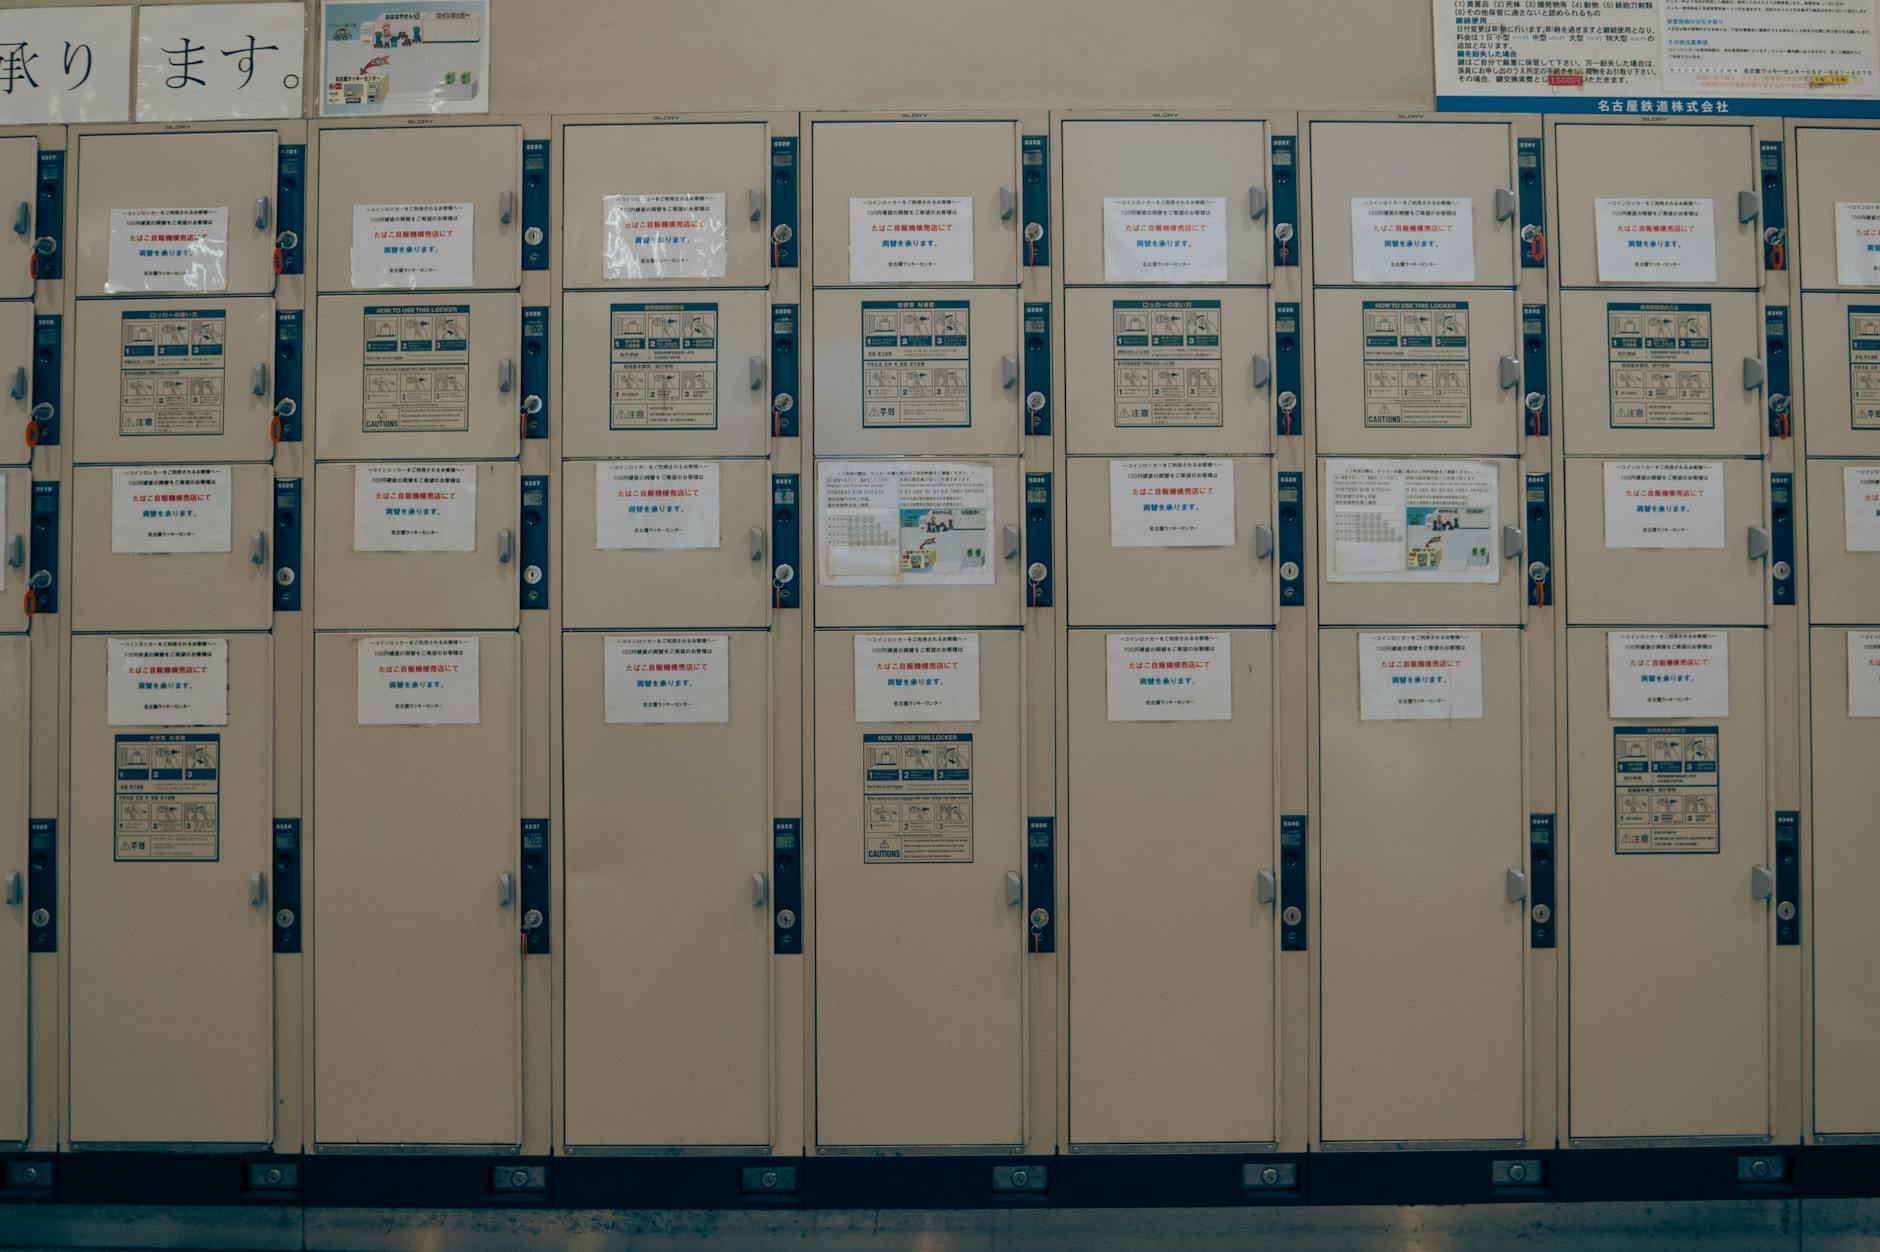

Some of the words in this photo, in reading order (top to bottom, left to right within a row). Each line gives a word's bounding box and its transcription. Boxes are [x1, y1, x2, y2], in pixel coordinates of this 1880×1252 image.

[1597, 100, 1729, 113] 名古屋鉄道株式会社
[1368, 415, 1401, 424] CAUTIONS
[366, 420, 398, 428] CAUTIONS
[868, 850, 900, 858] CAUTIONS
